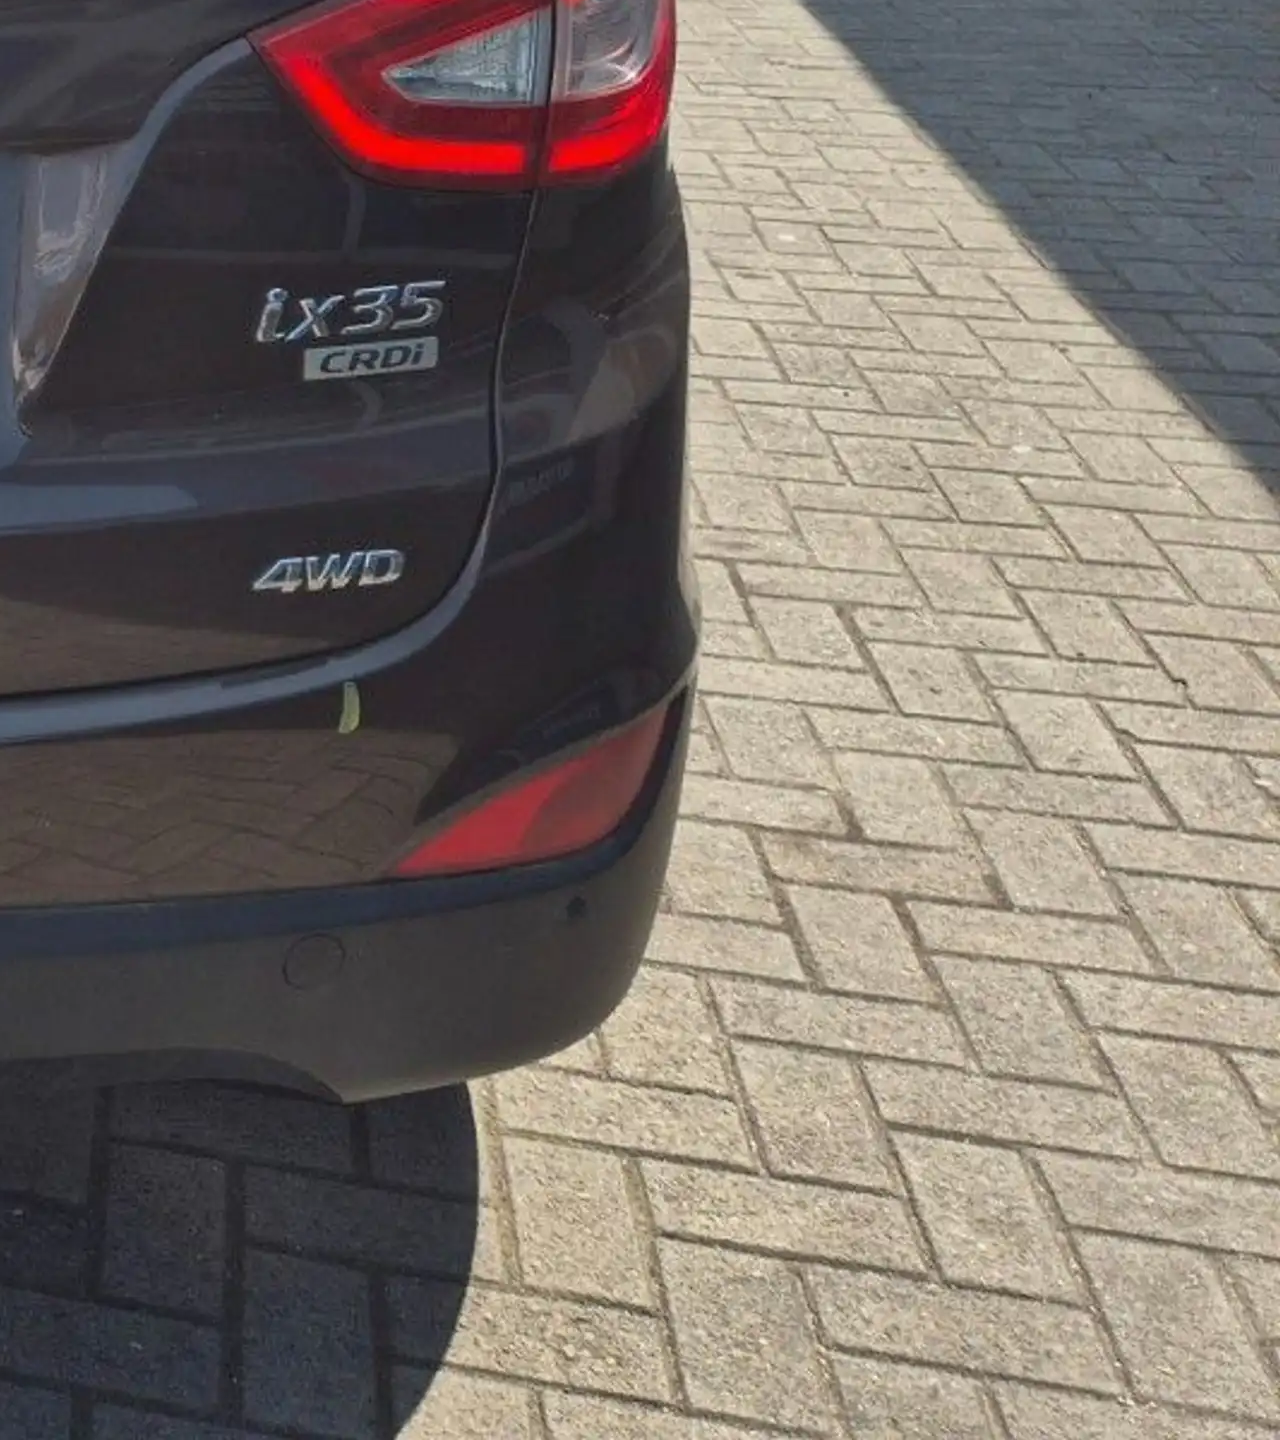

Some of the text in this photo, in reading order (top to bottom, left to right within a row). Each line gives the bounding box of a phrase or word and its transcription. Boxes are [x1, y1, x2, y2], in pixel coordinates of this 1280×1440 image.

[255, 279, 447, 344] ix35
[320, 342, 426, 374] CRDi
[252, 549, 405, 594] 4WD
